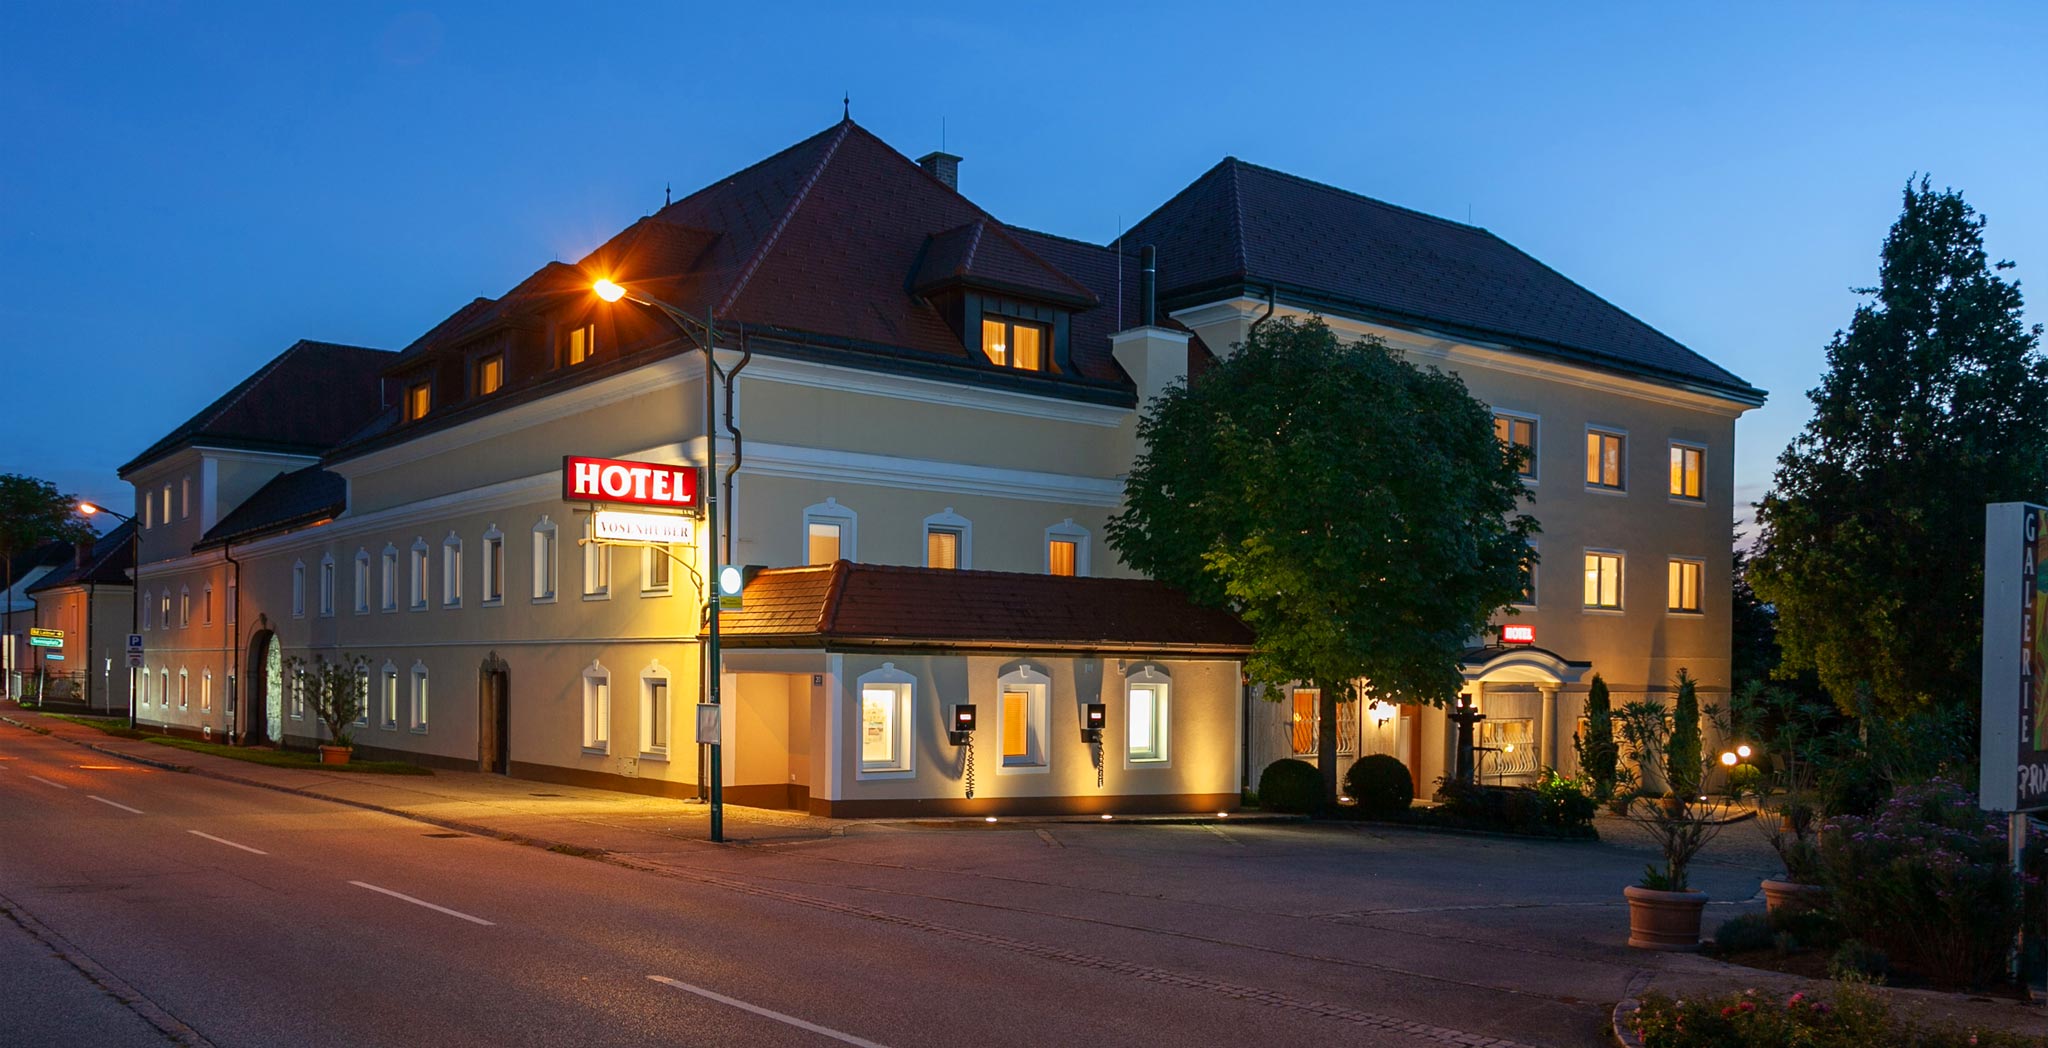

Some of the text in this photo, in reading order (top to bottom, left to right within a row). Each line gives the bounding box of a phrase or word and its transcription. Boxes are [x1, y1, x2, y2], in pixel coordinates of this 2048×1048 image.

[574, 463, 691, 502] HOTEL
[601, 521, 688, 538] VOSENHUBER
[1506, 628, 1532, 639] HOTEL
[2021, 513, 2035, 743] GALERIE
[131, 636, 140, 646] P
